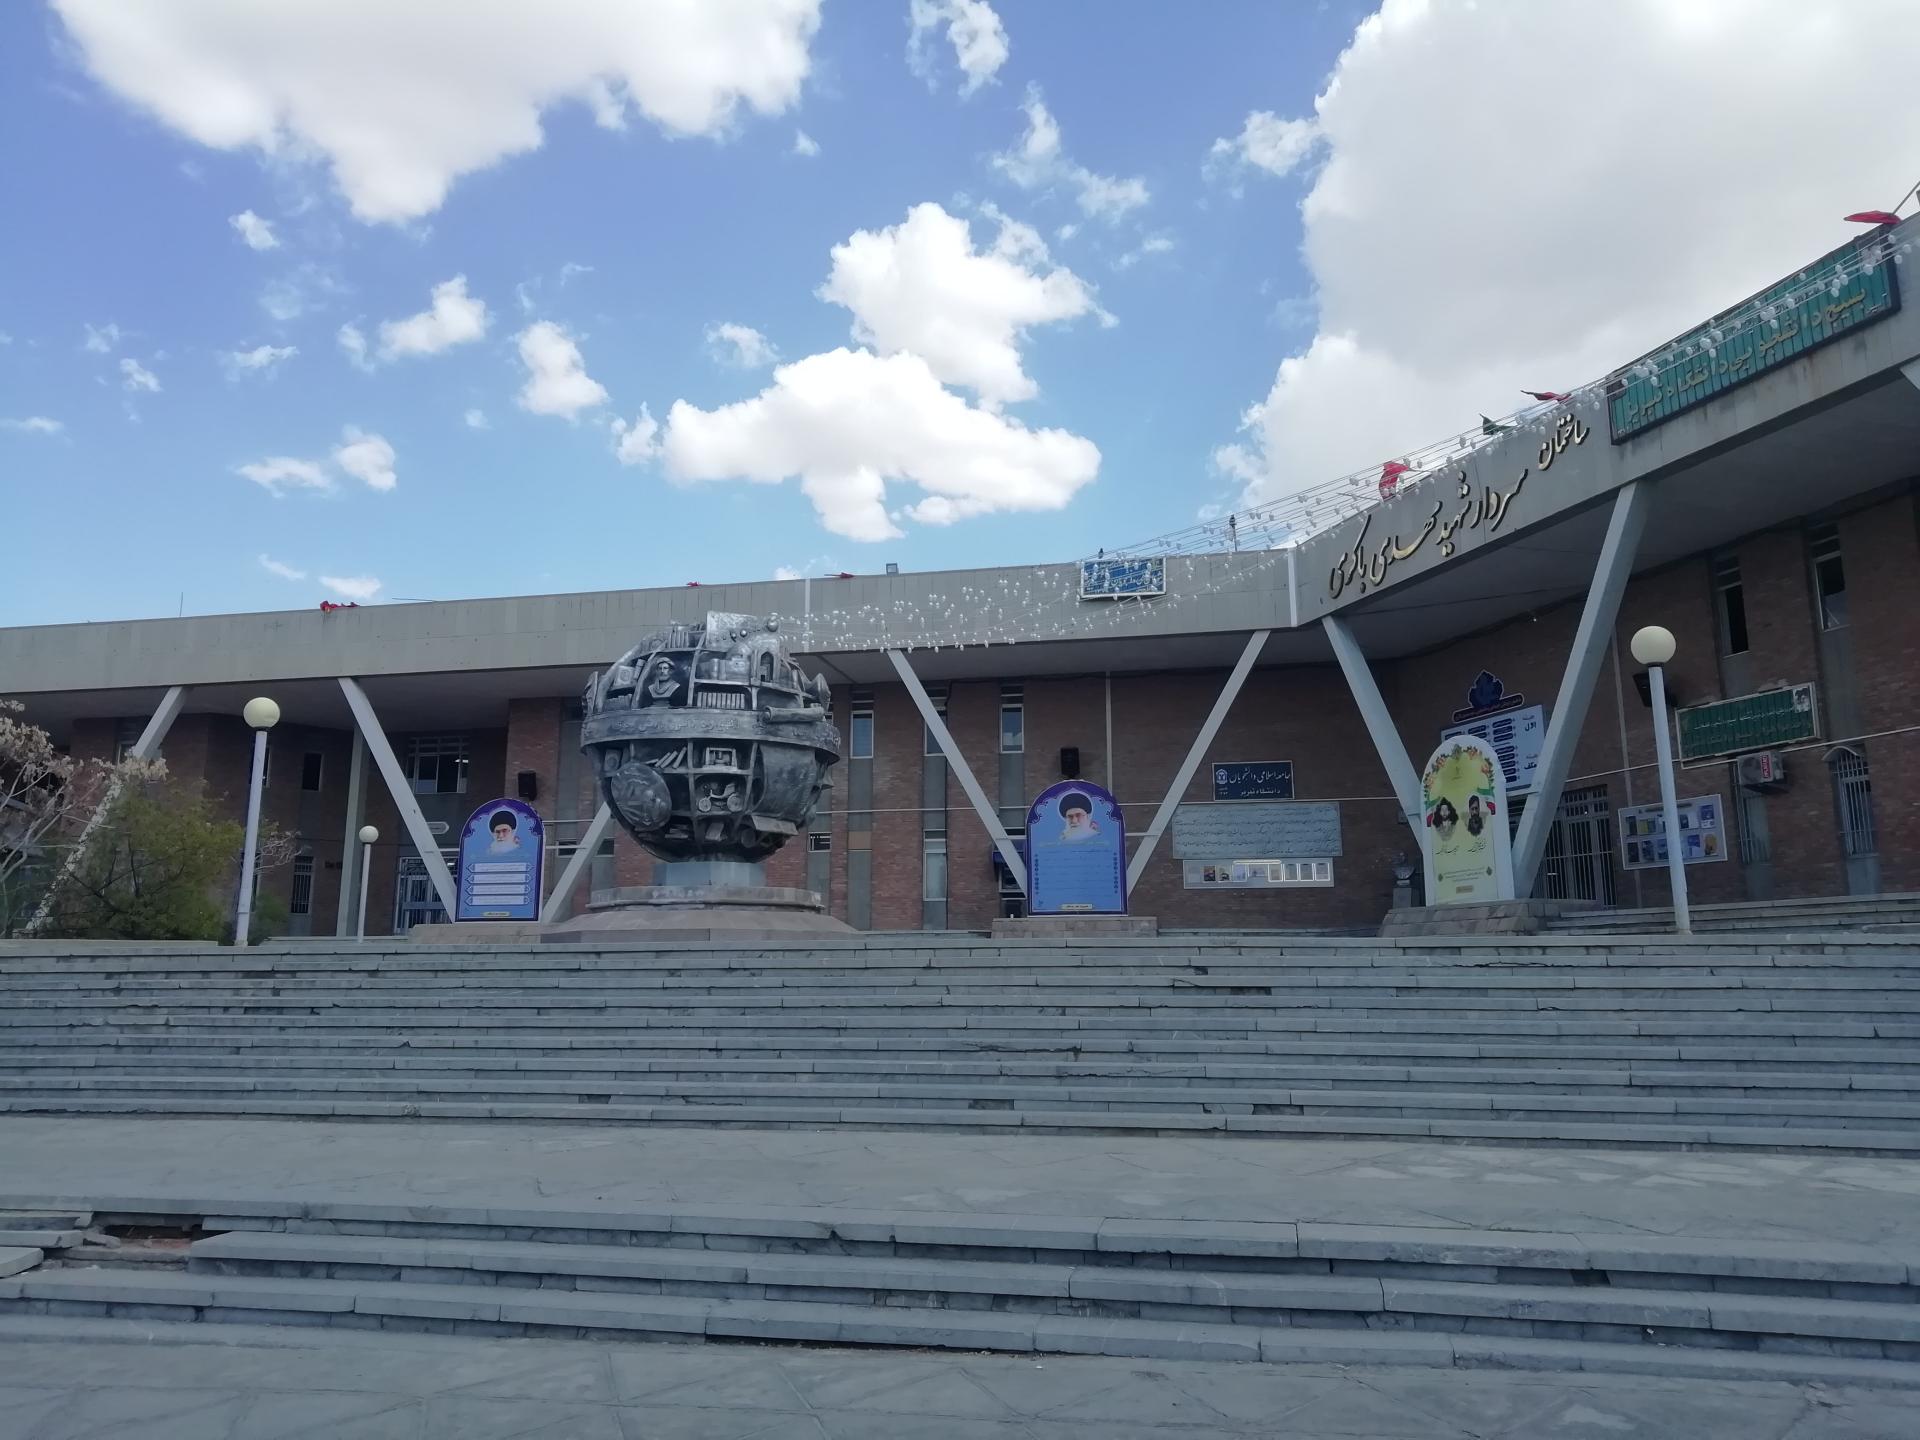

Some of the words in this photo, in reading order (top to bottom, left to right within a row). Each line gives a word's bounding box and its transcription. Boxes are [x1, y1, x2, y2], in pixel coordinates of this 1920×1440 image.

[1823, 286, 1867, 328] بسیج
[1729, 310, 1823, 380] دانشجویی
[1627, 382, 1664, 426] تبریز
[1667, 358, 1729, 400] دانشگاه
[1535, 412, 1590, 471] ساختمان
[1436, 470, 1473, 557] شهید
[1469, 467, 1530, 532] سردار
[1328, 513, 1372, 599] باکری
[1369, 500, 1444, 587] مهدی
[1229, 767, 1256, 784] دانشجویان
[1256, 769, 1277, 783] اسلامی
[1277, 770, 1291, 783] جامعه
